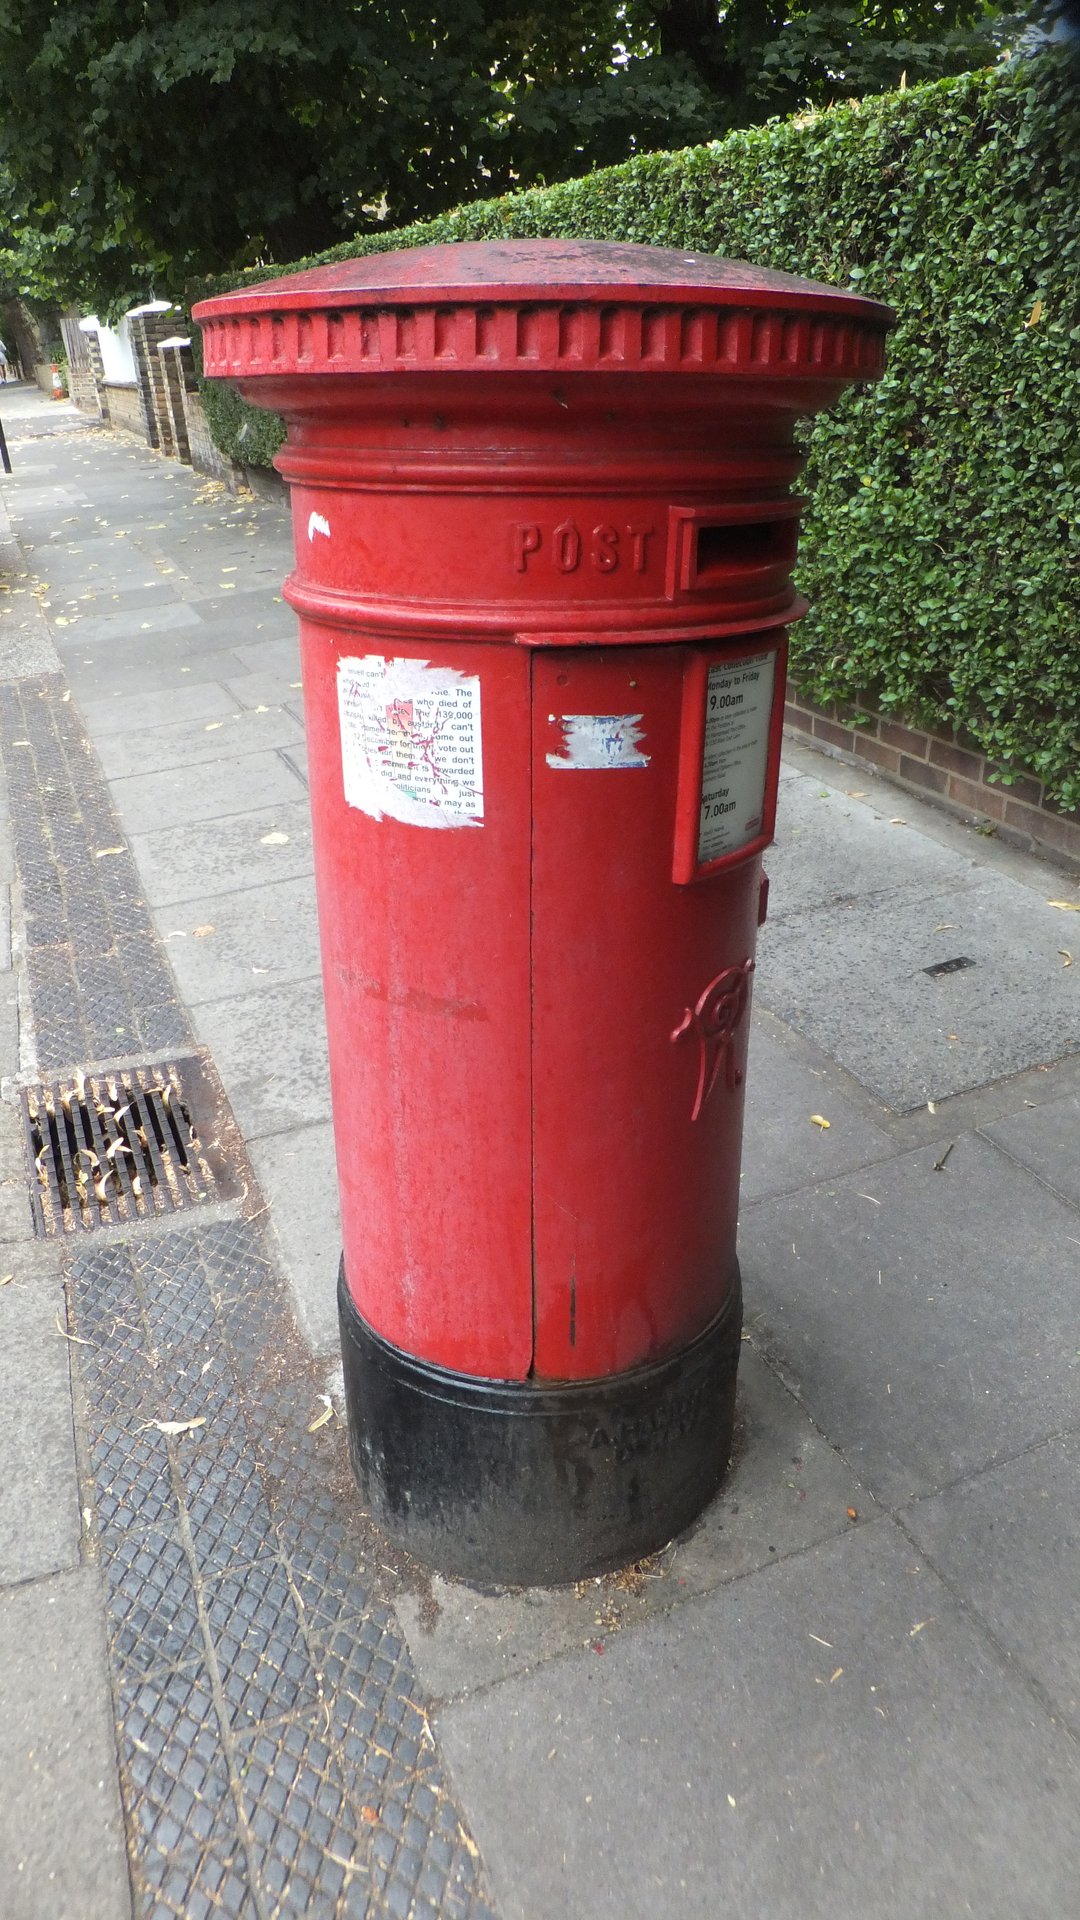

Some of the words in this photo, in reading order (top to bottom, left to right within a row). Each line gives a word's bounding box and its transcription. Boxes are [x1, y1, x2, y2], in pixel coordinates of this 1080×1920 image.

[515, 520, 652, 573] POST
[734, 676, 741, 685] to
[742, 671, 760, 683] Friday
[456, 689, 473, 698] The
[416, 698, 434, 706] who
[438, 700, 458, 708] died
[462, 700, 472, 708] of
[710, 693, 744, 712] 9.00am
[451, 723, 474, 732] can't
[434, 734, 454, 742] ome
[459, 735, 474, 743] out
[438, 745, 457, 753] vote
[459, 746, 474, 754] out
[452, 756, 475, 765] don't
[380, 770, 393, 778] did
[397, 773, 412, 781] and
[461, 779, 475, 787] we
[444, 800, 463, 809] may
[704, 800, 737, 821] 7.00am
